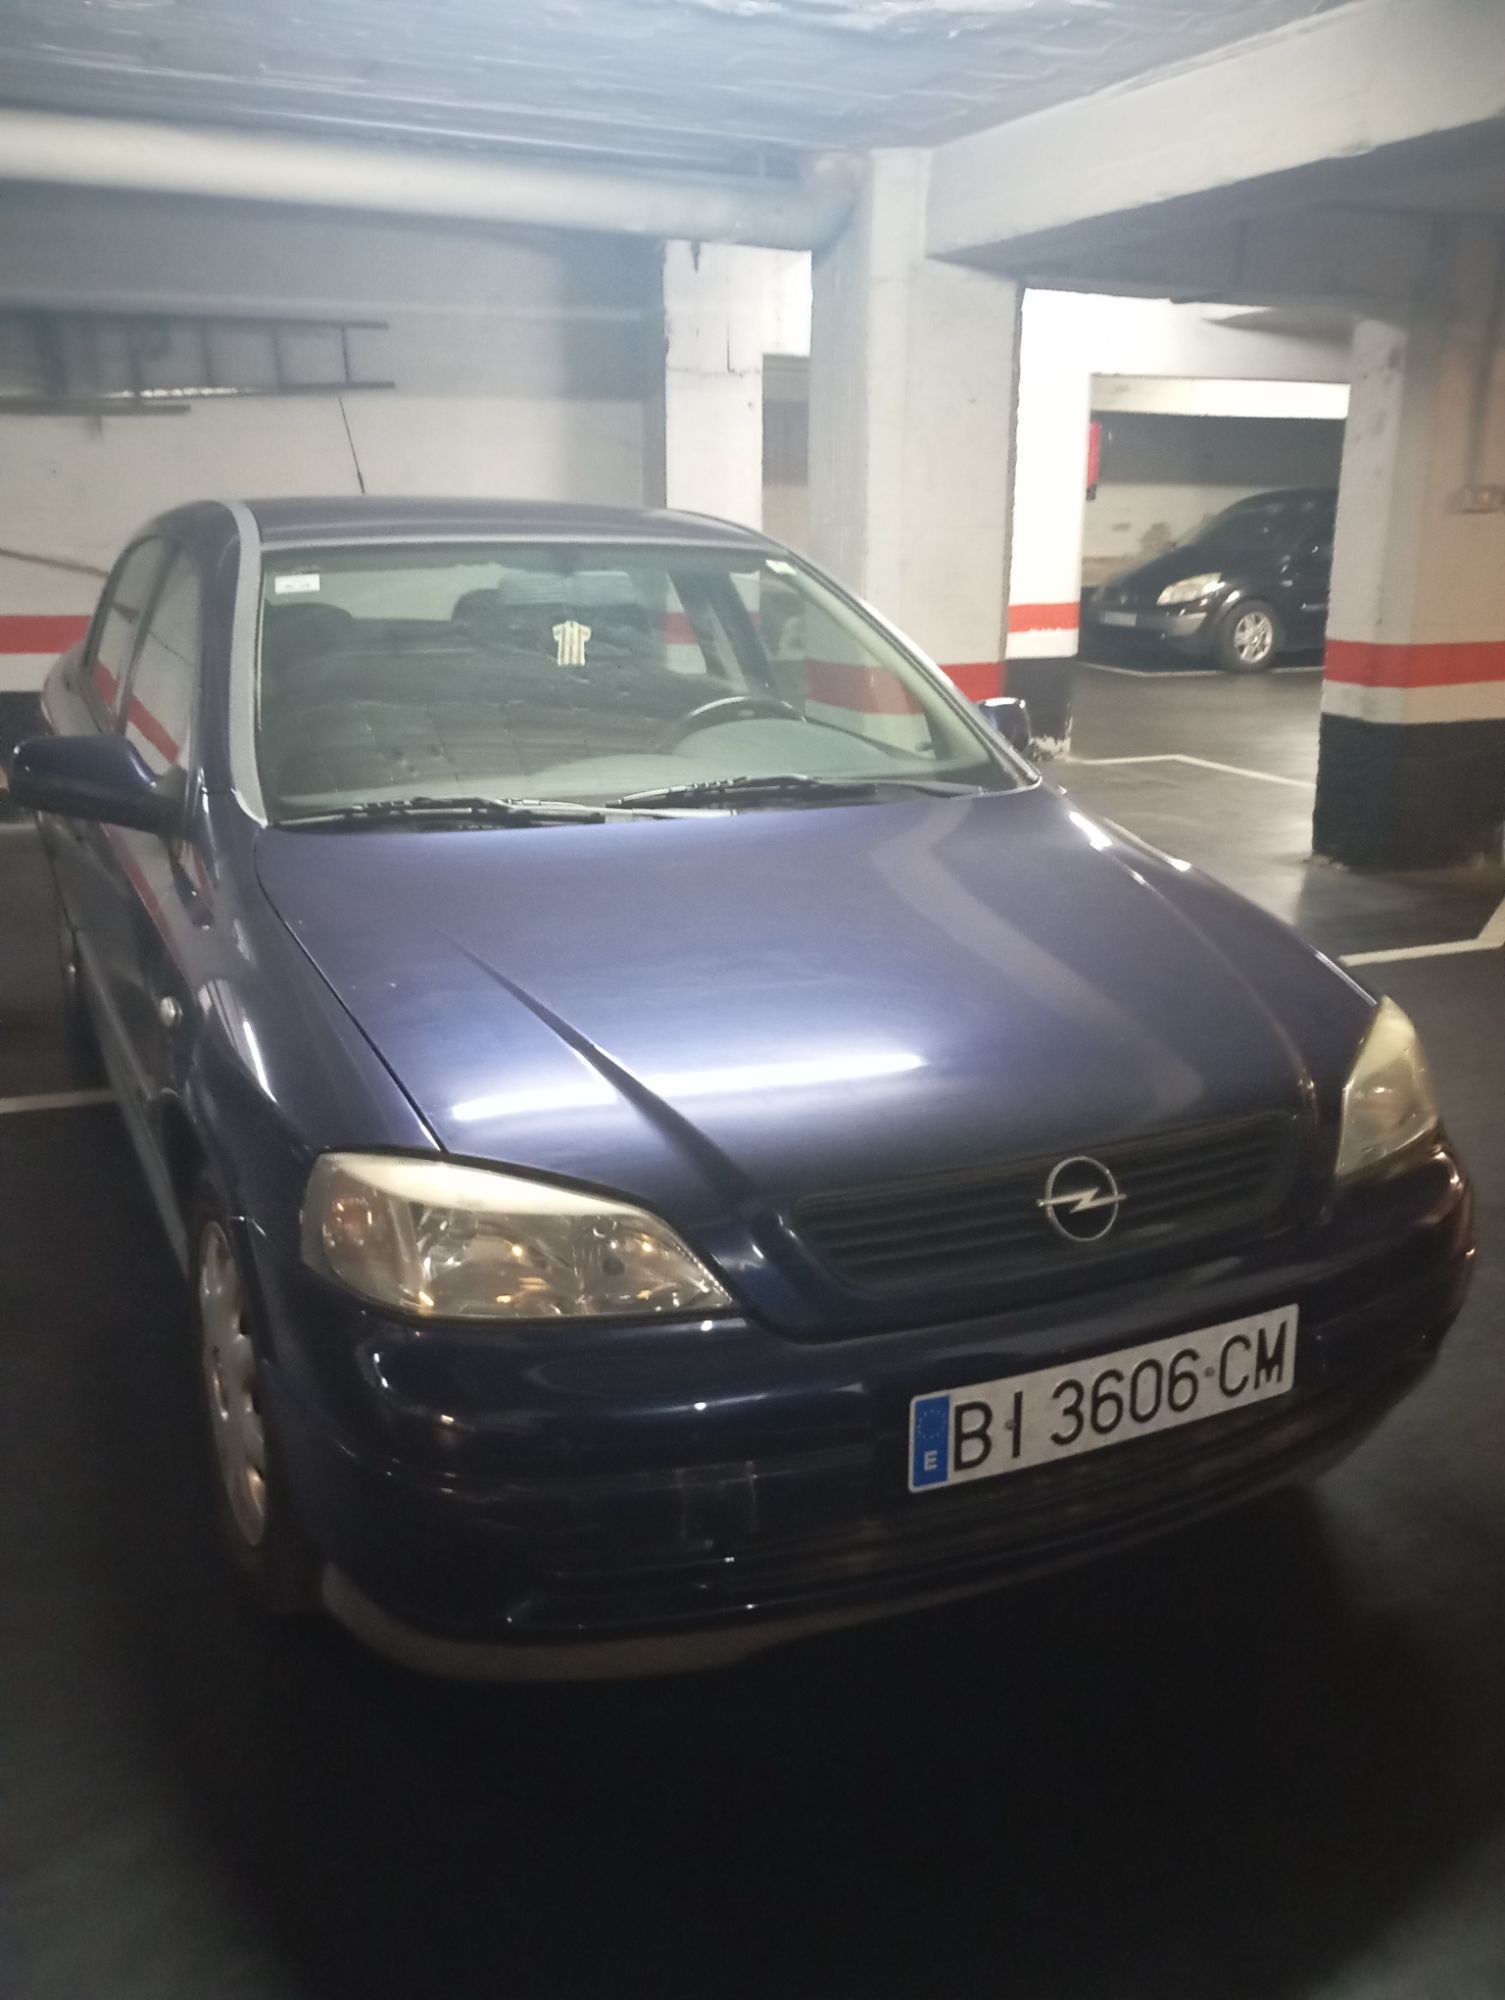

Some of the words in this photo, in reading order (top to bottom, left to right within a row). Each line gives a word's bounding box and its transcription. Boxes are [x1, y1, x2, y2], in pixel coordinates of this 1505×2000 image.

[953, 1391, 1023, 1471] BI
[1050, 1348, 1199, 1446] 3606
[1219, 1320, 1288, 1398] CM
[923, 1450, 938, 1472] E
